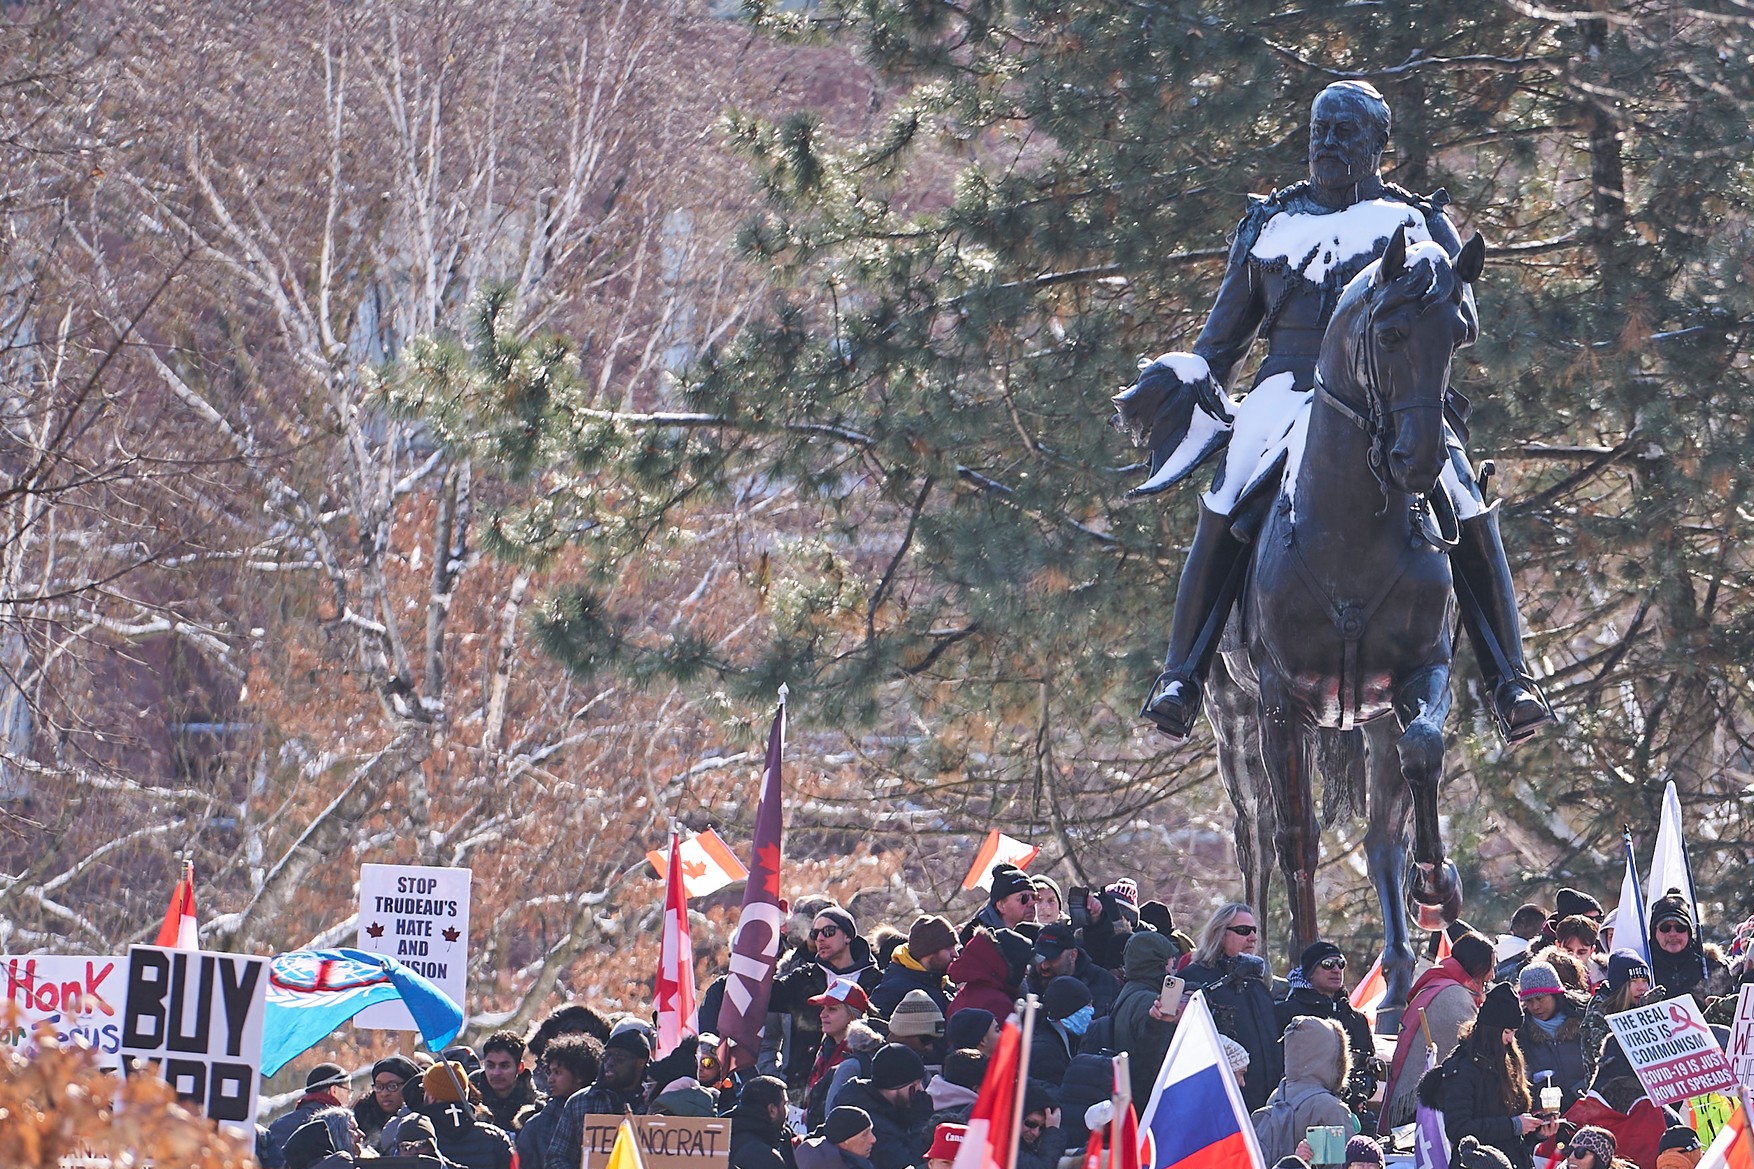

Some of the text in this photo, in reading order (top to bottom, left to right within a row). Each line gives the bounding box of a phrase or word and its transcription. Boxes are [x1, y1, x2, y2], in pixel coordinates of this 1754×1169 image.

[397, 876, 437, 894] STOP
[374, 896, 457, 917] TRUDEAU'S
[395, 918, 433, 937] HATE
[397, 939, 429, 957] AND
[121, 948, 263, 1057] BUY
[1612, 1006, 1669, 1033] THE REAL
[1621, 1023, 1673, 1048] VIRUS IS
[1631, 1033, 1708, 1065] COMMUNISM
[1641, 1053, 1725, 1085] COVID-19 IS JUST
[1652, 1068, 1733, 1101] HOW IT SPREADS
[586, 1124, 722, 1158] TENOCRAT
